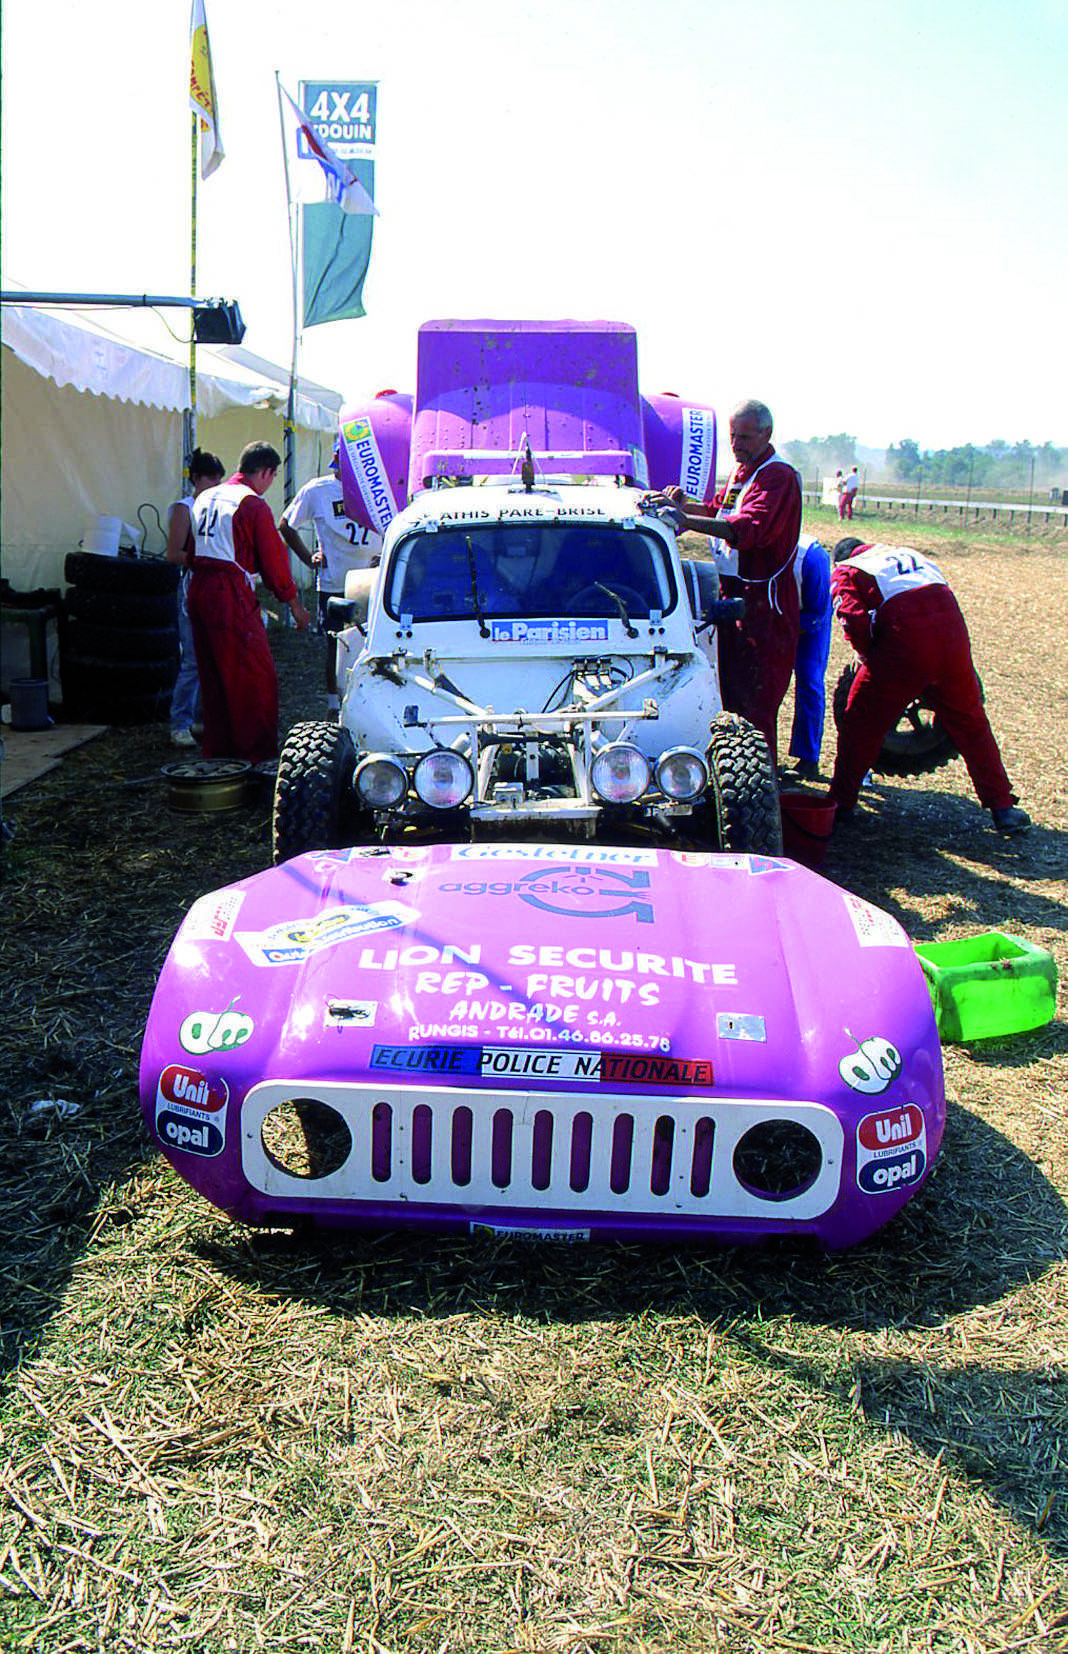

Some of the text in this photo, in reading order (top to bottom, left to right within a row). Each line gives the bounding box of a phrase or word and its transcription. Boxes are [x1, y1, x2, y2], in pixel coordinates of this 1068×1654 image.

[310, 91, 370, 123] 4X4
[313, 124, 372, 139] DOUIN
[686, 409, 704, 496] EUROMASTER
[199, 508, 219, 537] 22
[440, 509, 490, 520] ATHIS
[345, 522, 369, 545] 22
[886, 553, 924, 575] 22
[495, 621, 606, 641] le Parisien
[438, 881, 594, 896] aggreko
[358, 944, 738, 985] LION SECURITE
[415, 972, 489, 996] REP
[526, 973, 661, 1007] FRUITS
[449, 999, 622, 1027] ANDRADE S.A.
[408, 1024, 479, 1041] RUNGIS
[375, 1049, 709, 1083] ECURIE POLICE NATIONALE
[173, 1074, 209, 1105] Unil
[167, 1102, 211, 1121] LUBRIFIANTS
[166, 1122, 209, 1148] opal
[875, 1113, 913, 1143] Unil
[873, 1142, 917, 1158] LUBRIFIANTS
[873, 1154, 917, 1187] opal
[497, 1231, 584, 1242] EUROMASTER
